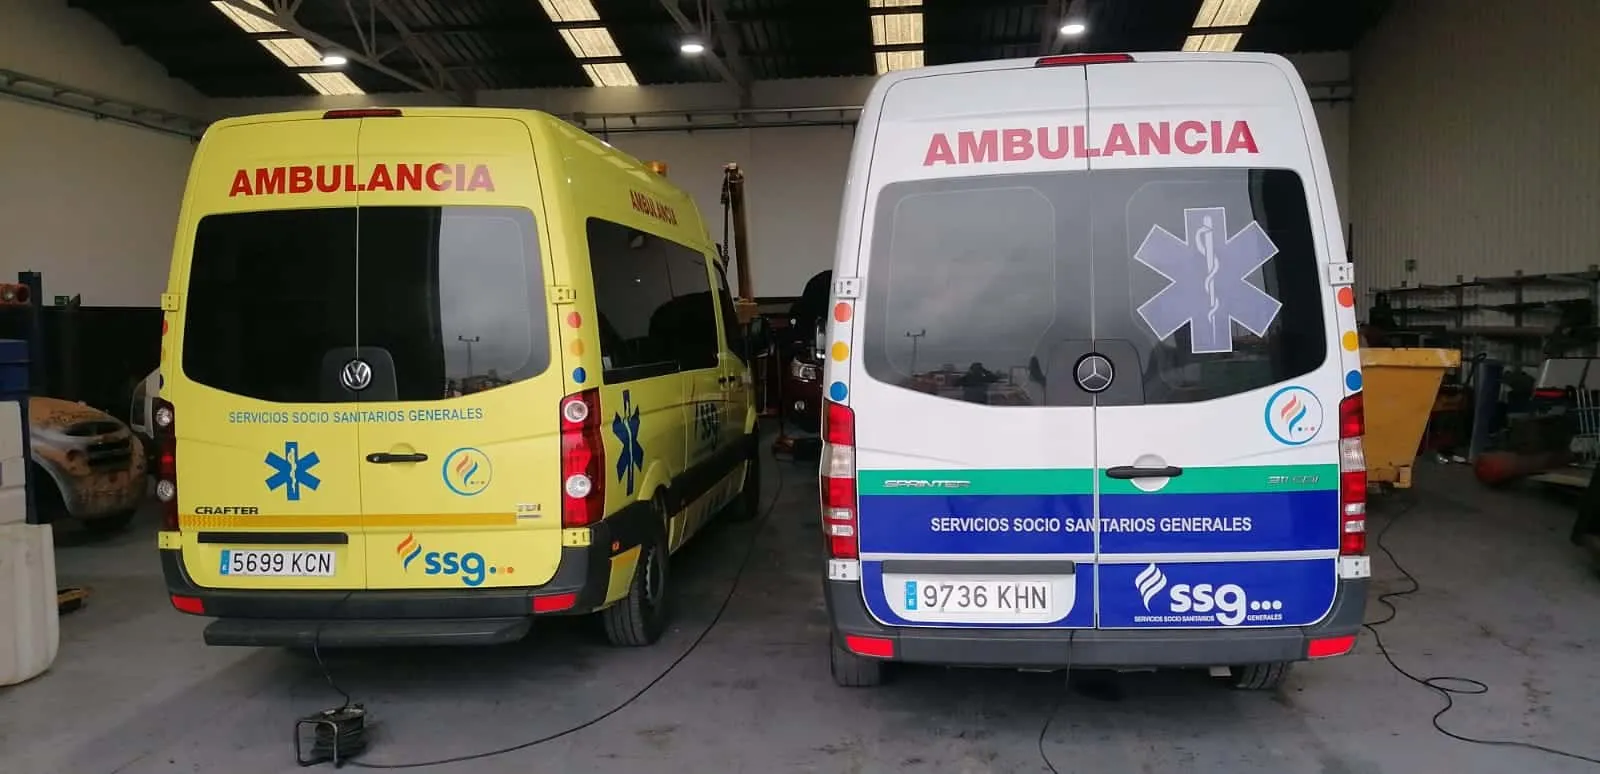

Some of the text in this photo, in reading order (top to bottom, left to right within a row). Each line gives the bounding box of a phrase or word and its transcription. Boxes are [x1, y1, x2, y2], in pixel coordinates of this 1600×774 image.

[922, 120, 1259, 166] AMBULANCIA
[229, 163, 495, 197] AMBULANCIA
[229, 408, 483, 424] SERVICIOS SOCIO SANITARIOS GENERALES
[884, 479, 971, 488] SPRINTER
[194, 506, 259, 515] CRAFTER
[931, 517, 1009, 532] SERVICIOS
[1013, 517, 1060, 532] SOCIO
[1160, 516, 1252, 532] GENERALES
[233, 553, 331, 573] 5699 KCN
[923, 585, 1046, 609] 9736 KHN
